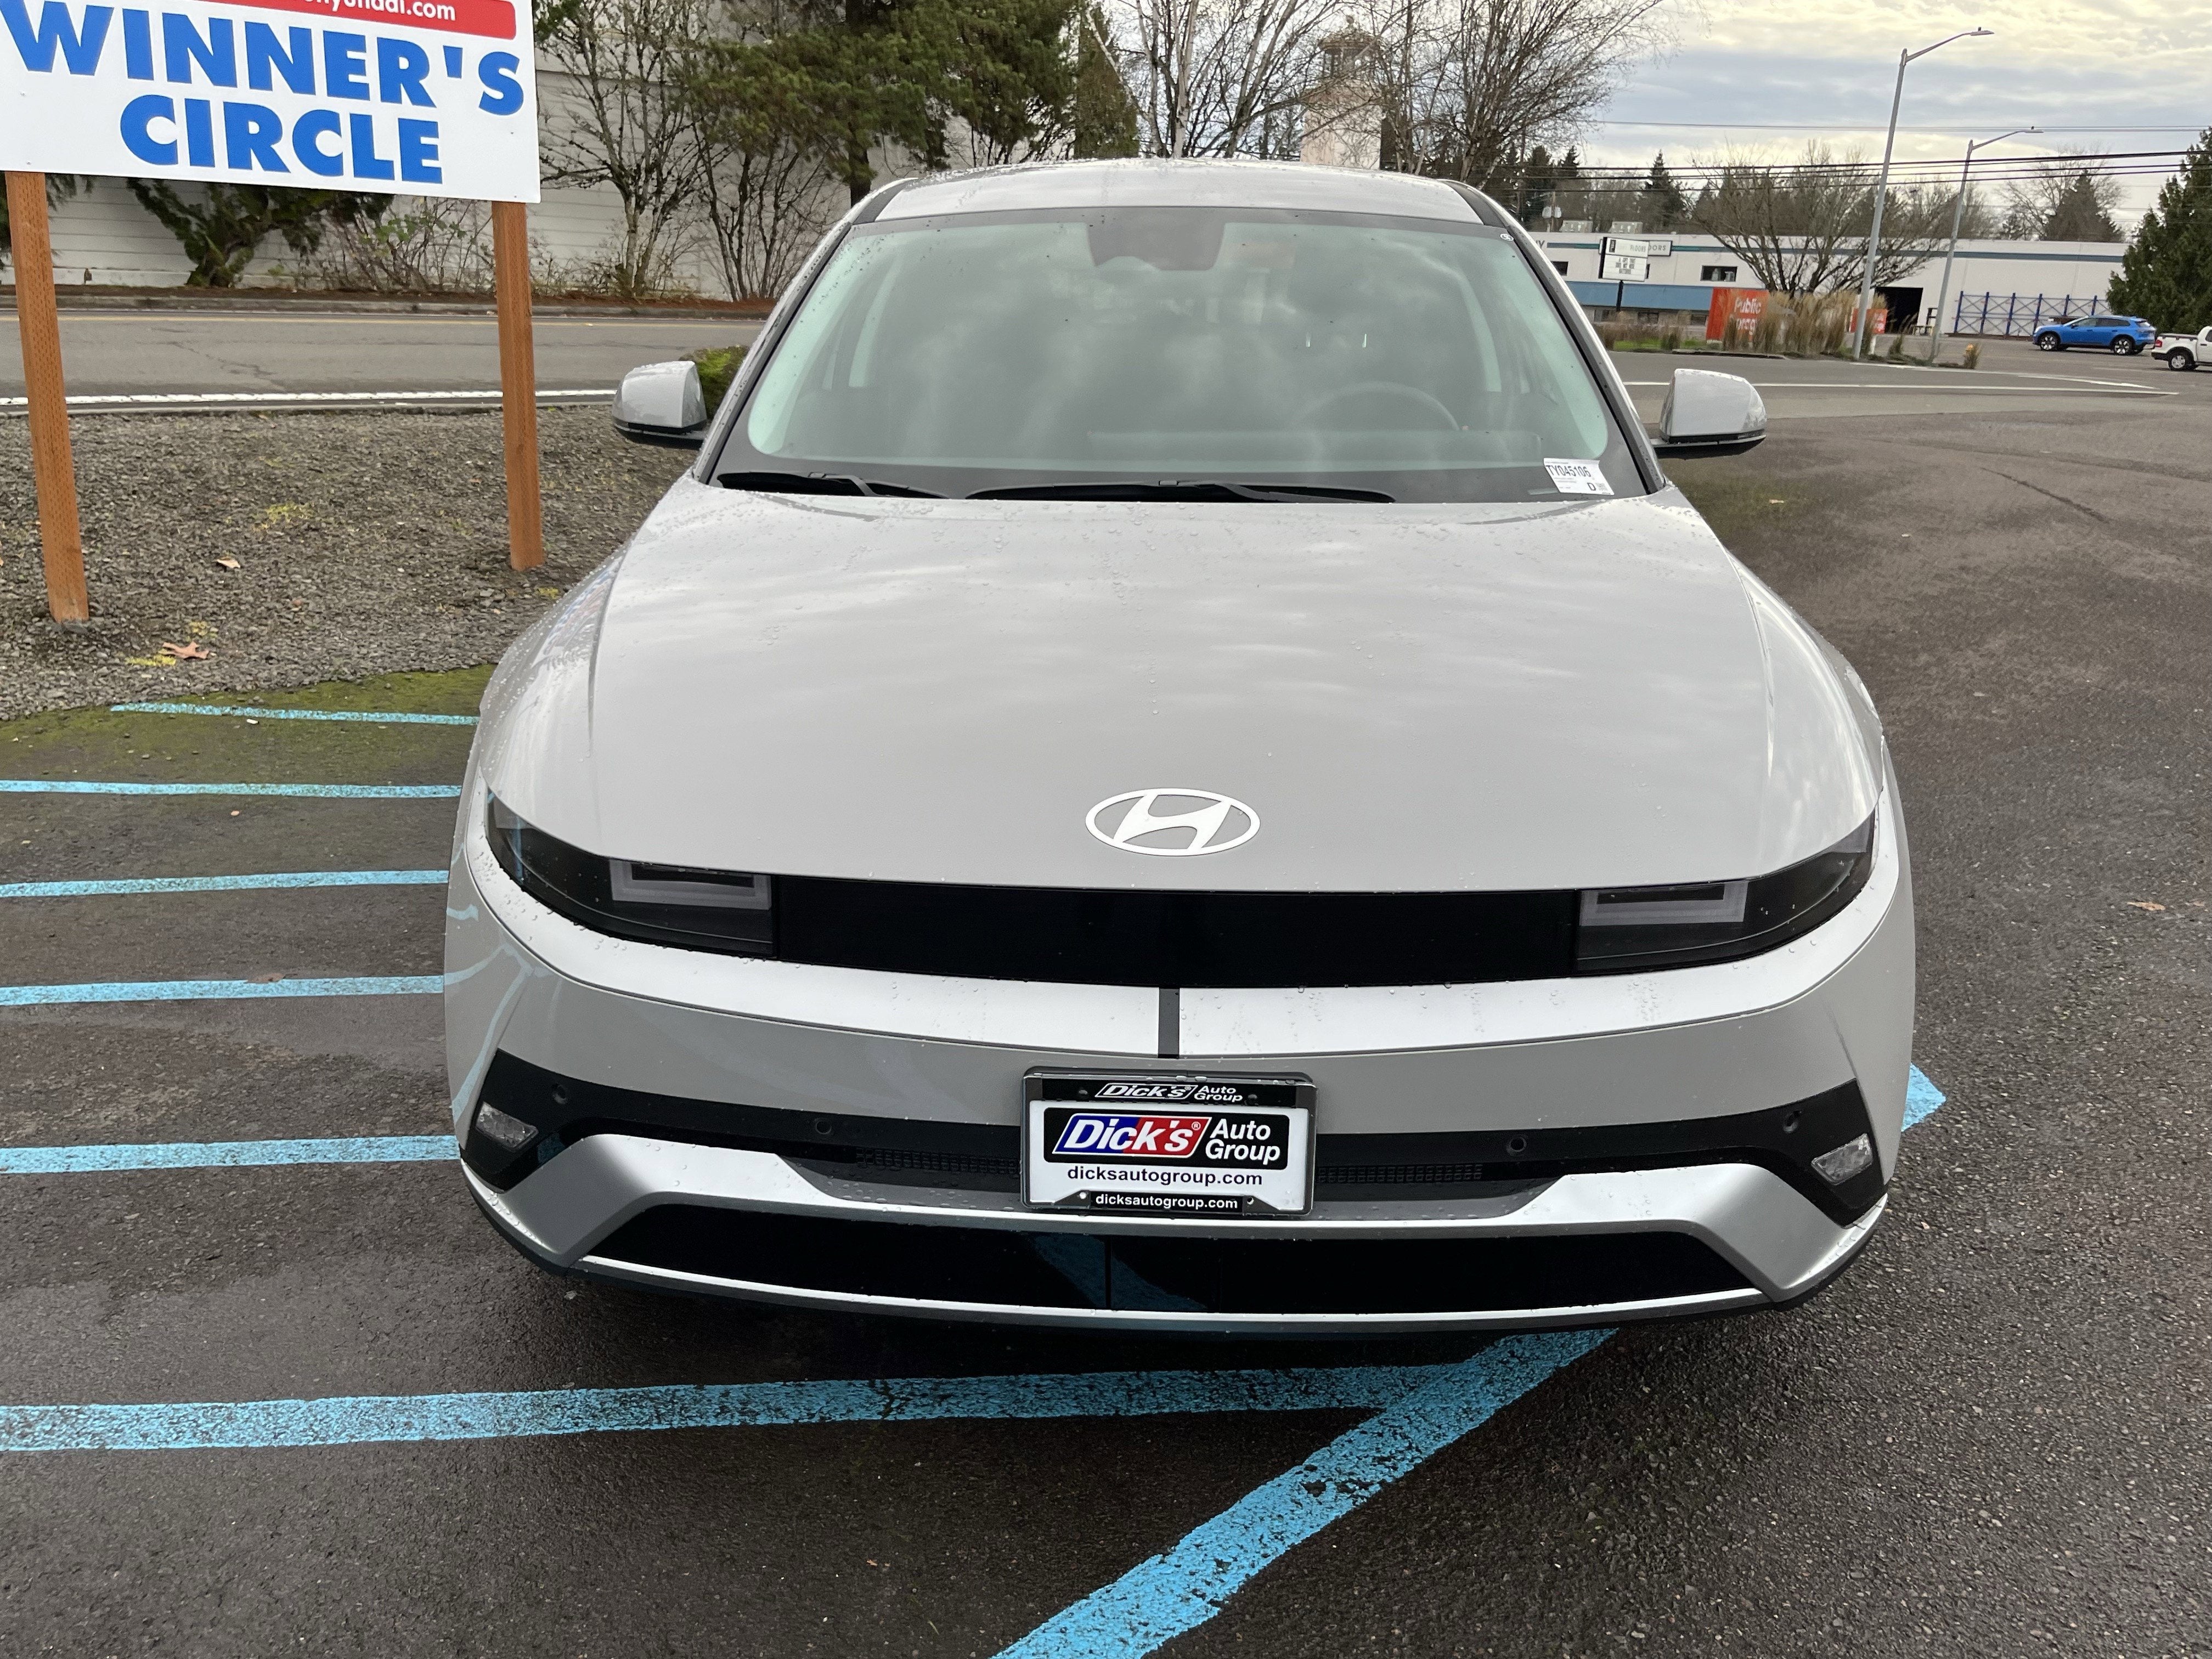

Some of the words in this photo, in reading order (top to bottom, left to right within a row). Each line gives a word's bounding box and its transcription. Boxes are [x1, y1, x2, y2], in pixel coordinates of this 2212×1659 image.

[0, 0, 524, 116] WINNER'S
[120, 94, 443, 185] CIRCLE
[1545, 465, 1592, 477] TY045106
[1103, 1085, 1186, 1097] Dick's
[1194, 1093, 1243, 1103] Group
[1198, 1085, 1236, 1094] Auto
[1063, 1119, 1193, 1153] Dick's
[1209, 1118, 1271, 1141] Auto
[1205, 1138, 1281, 1166] Group
[1067, 1165, 1263, 1187] dicksautogroup.com
[1095, 1193, 1238, 1211] dicksautogroup.com
